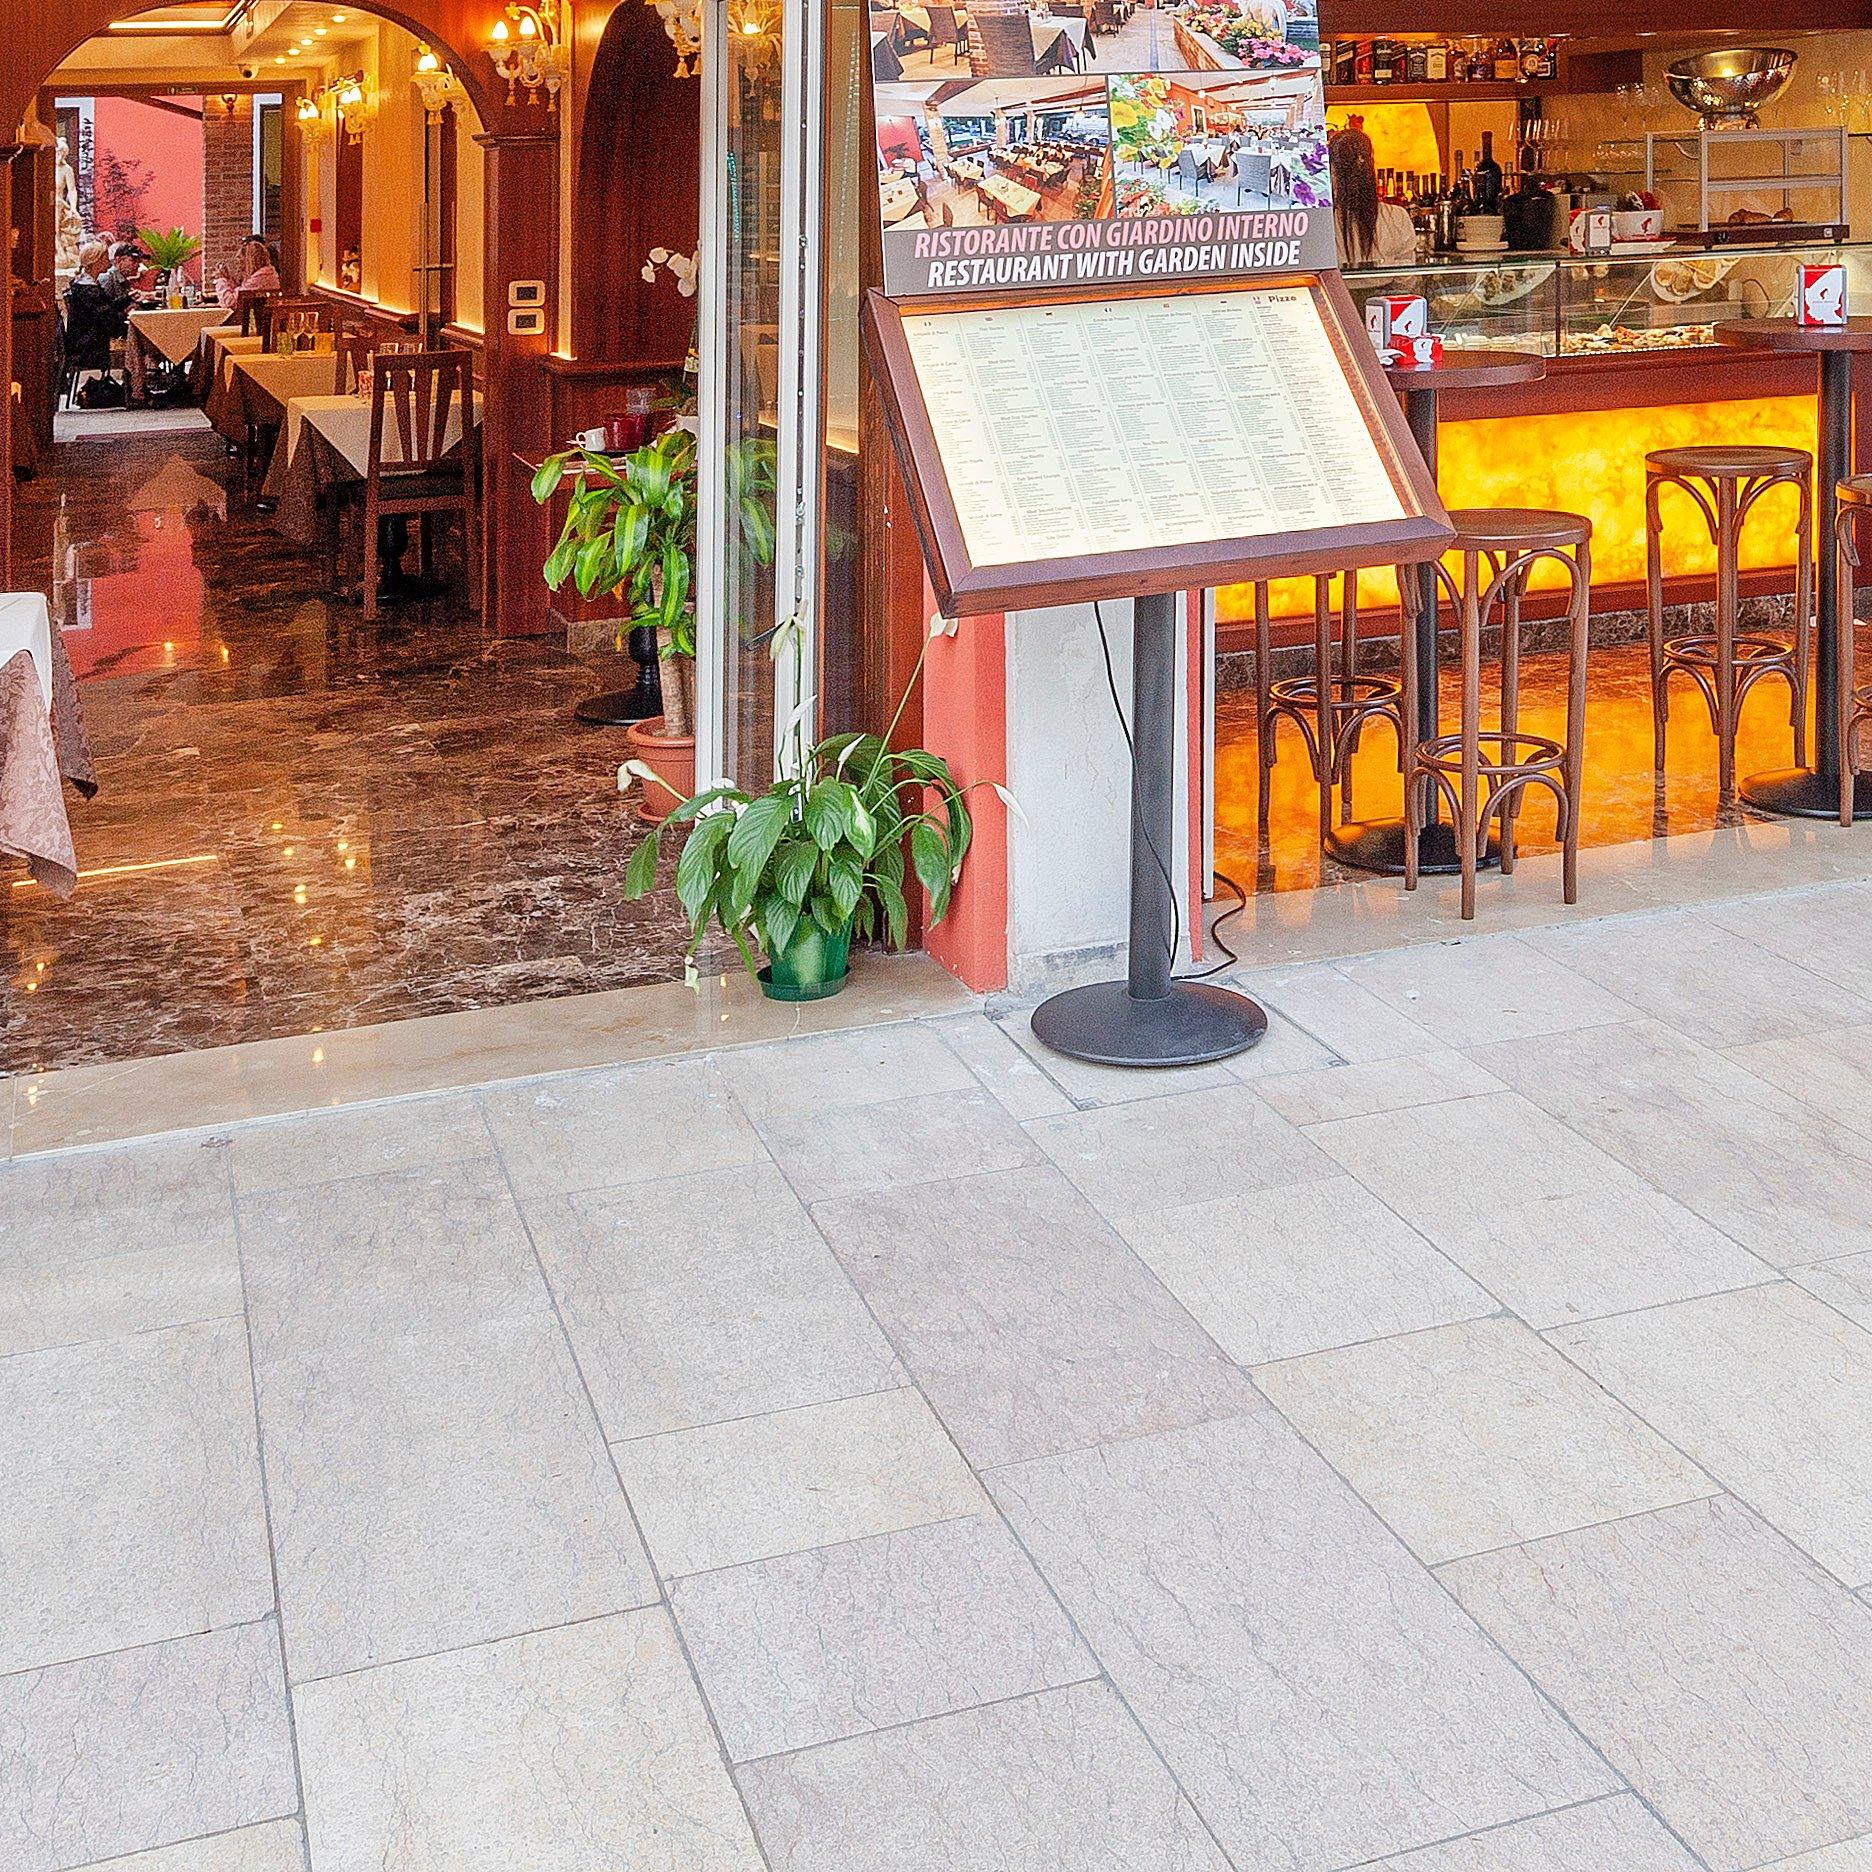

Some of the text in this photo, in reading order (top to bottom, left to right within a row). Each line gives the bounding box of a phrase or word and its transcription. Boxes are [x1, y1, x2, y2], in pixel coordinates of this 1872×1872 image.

[914, 211, 1309, 259] RISTORANTE CON GIARDINO INTERNO
[927, 239, 1301, 288] RESTAURANT WITH GARDEN INSIDE
